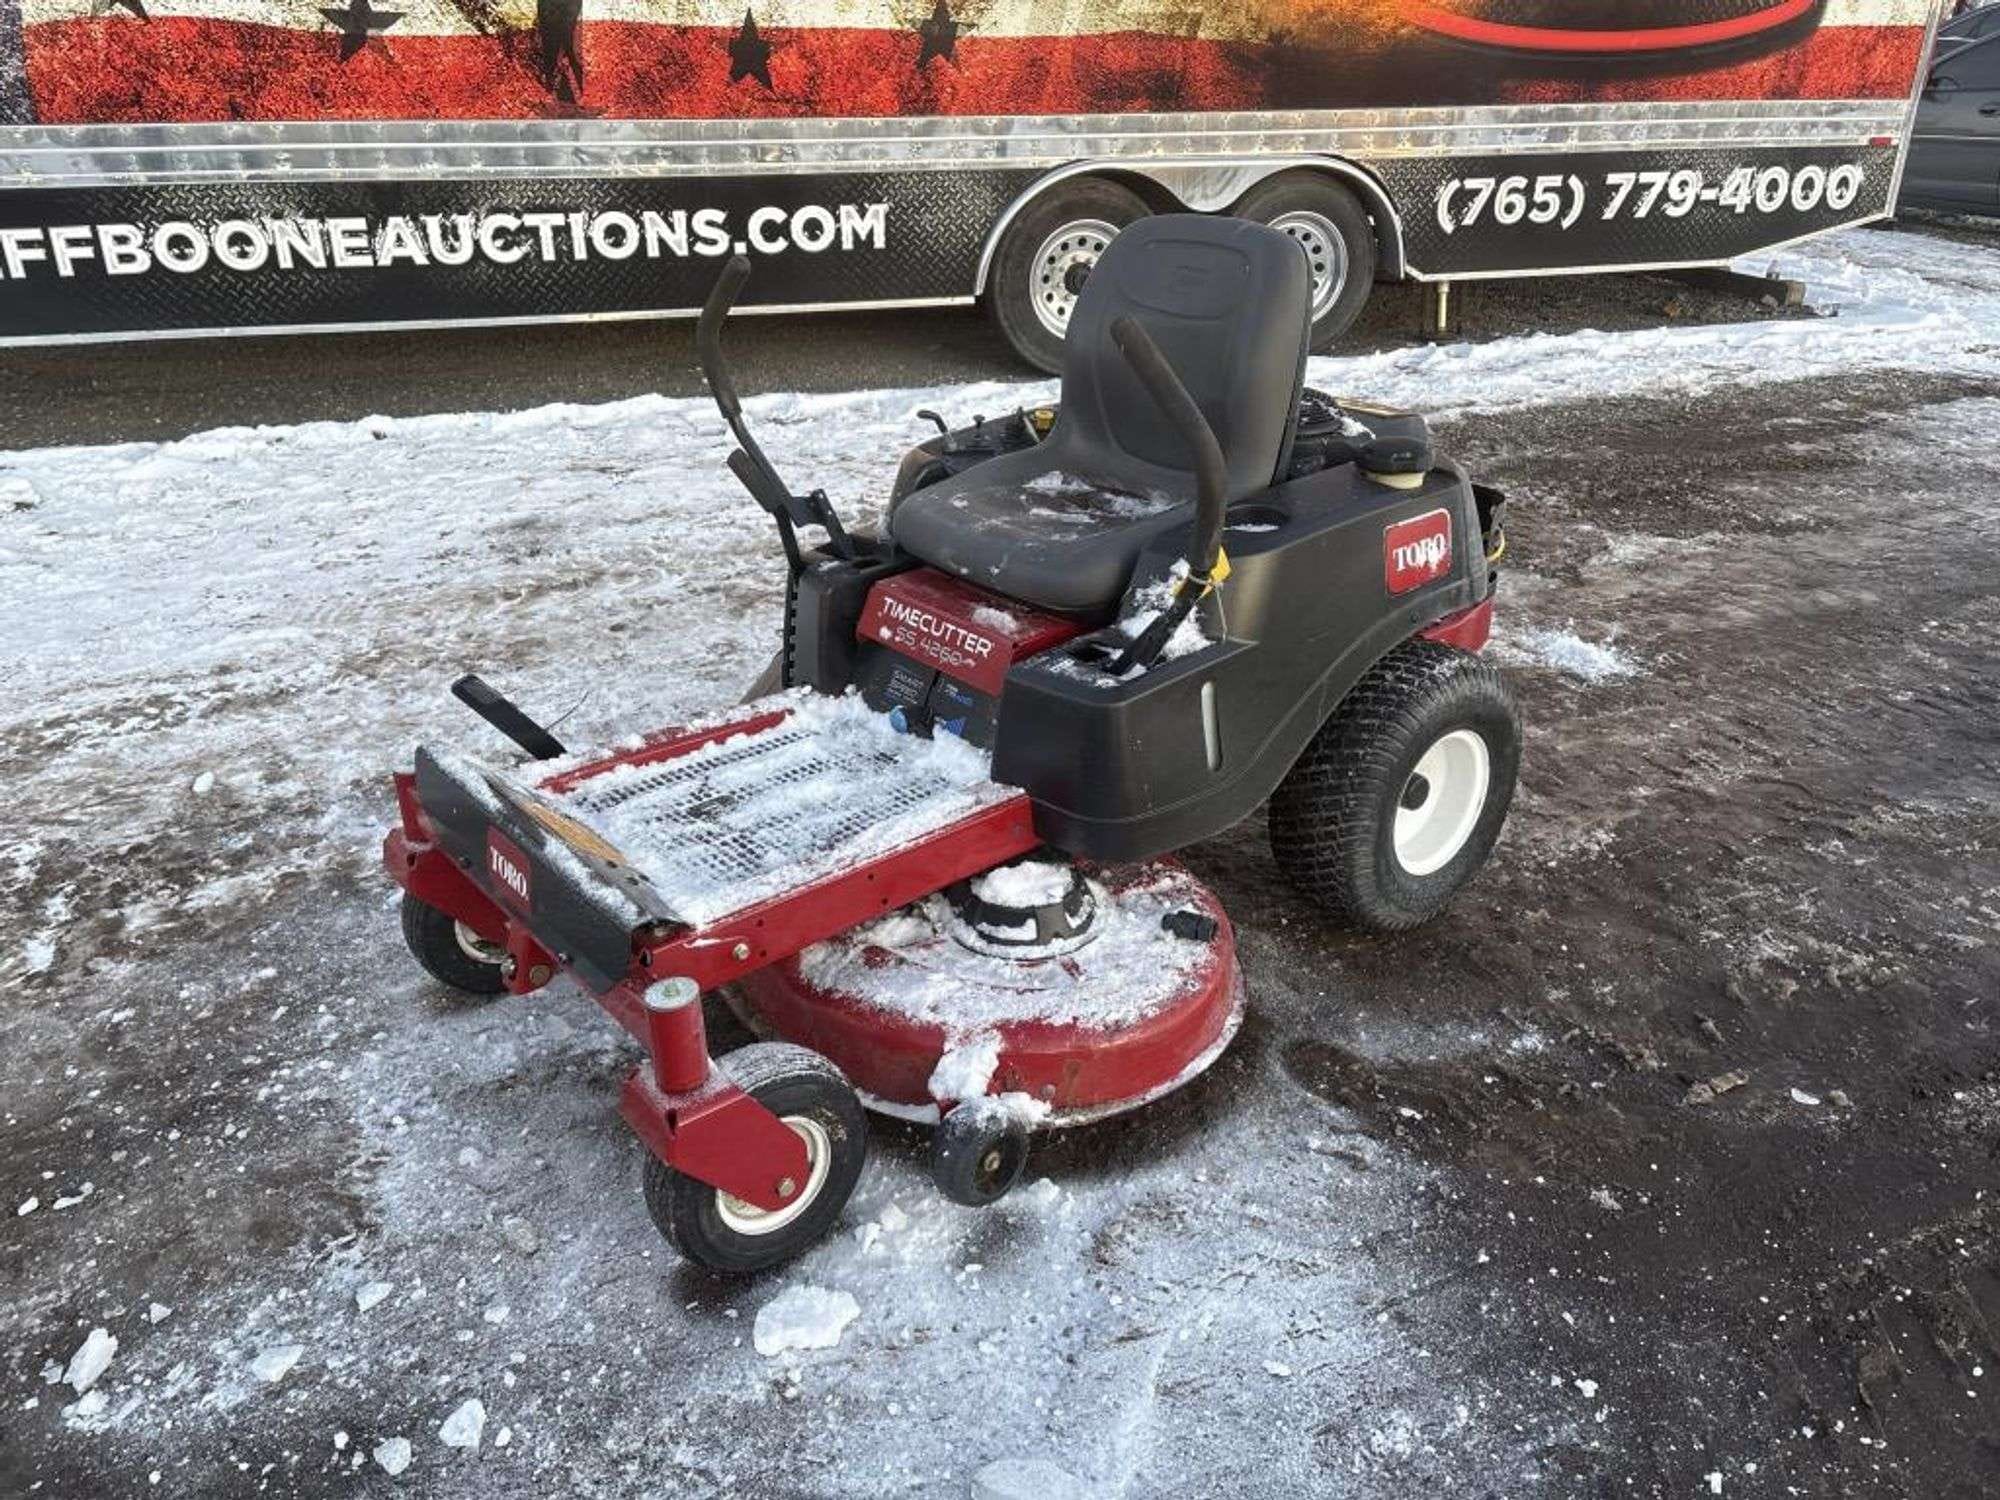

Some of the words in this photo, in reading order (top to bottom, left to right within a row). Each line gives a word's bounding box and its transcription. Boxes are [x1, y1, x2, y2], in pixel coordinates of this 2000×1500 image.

[1436, 174, 1586, 234] (765)
[1601, 164, 1862, 220] 779-4000
[0, 204, 888, 280] FFBOONEAUCTIONS.COM
[1392, 532, 1446, 571] TORO
[883, 597, 992, 657] TIMECUTTER
[490, 846, 527, 897] TORO
